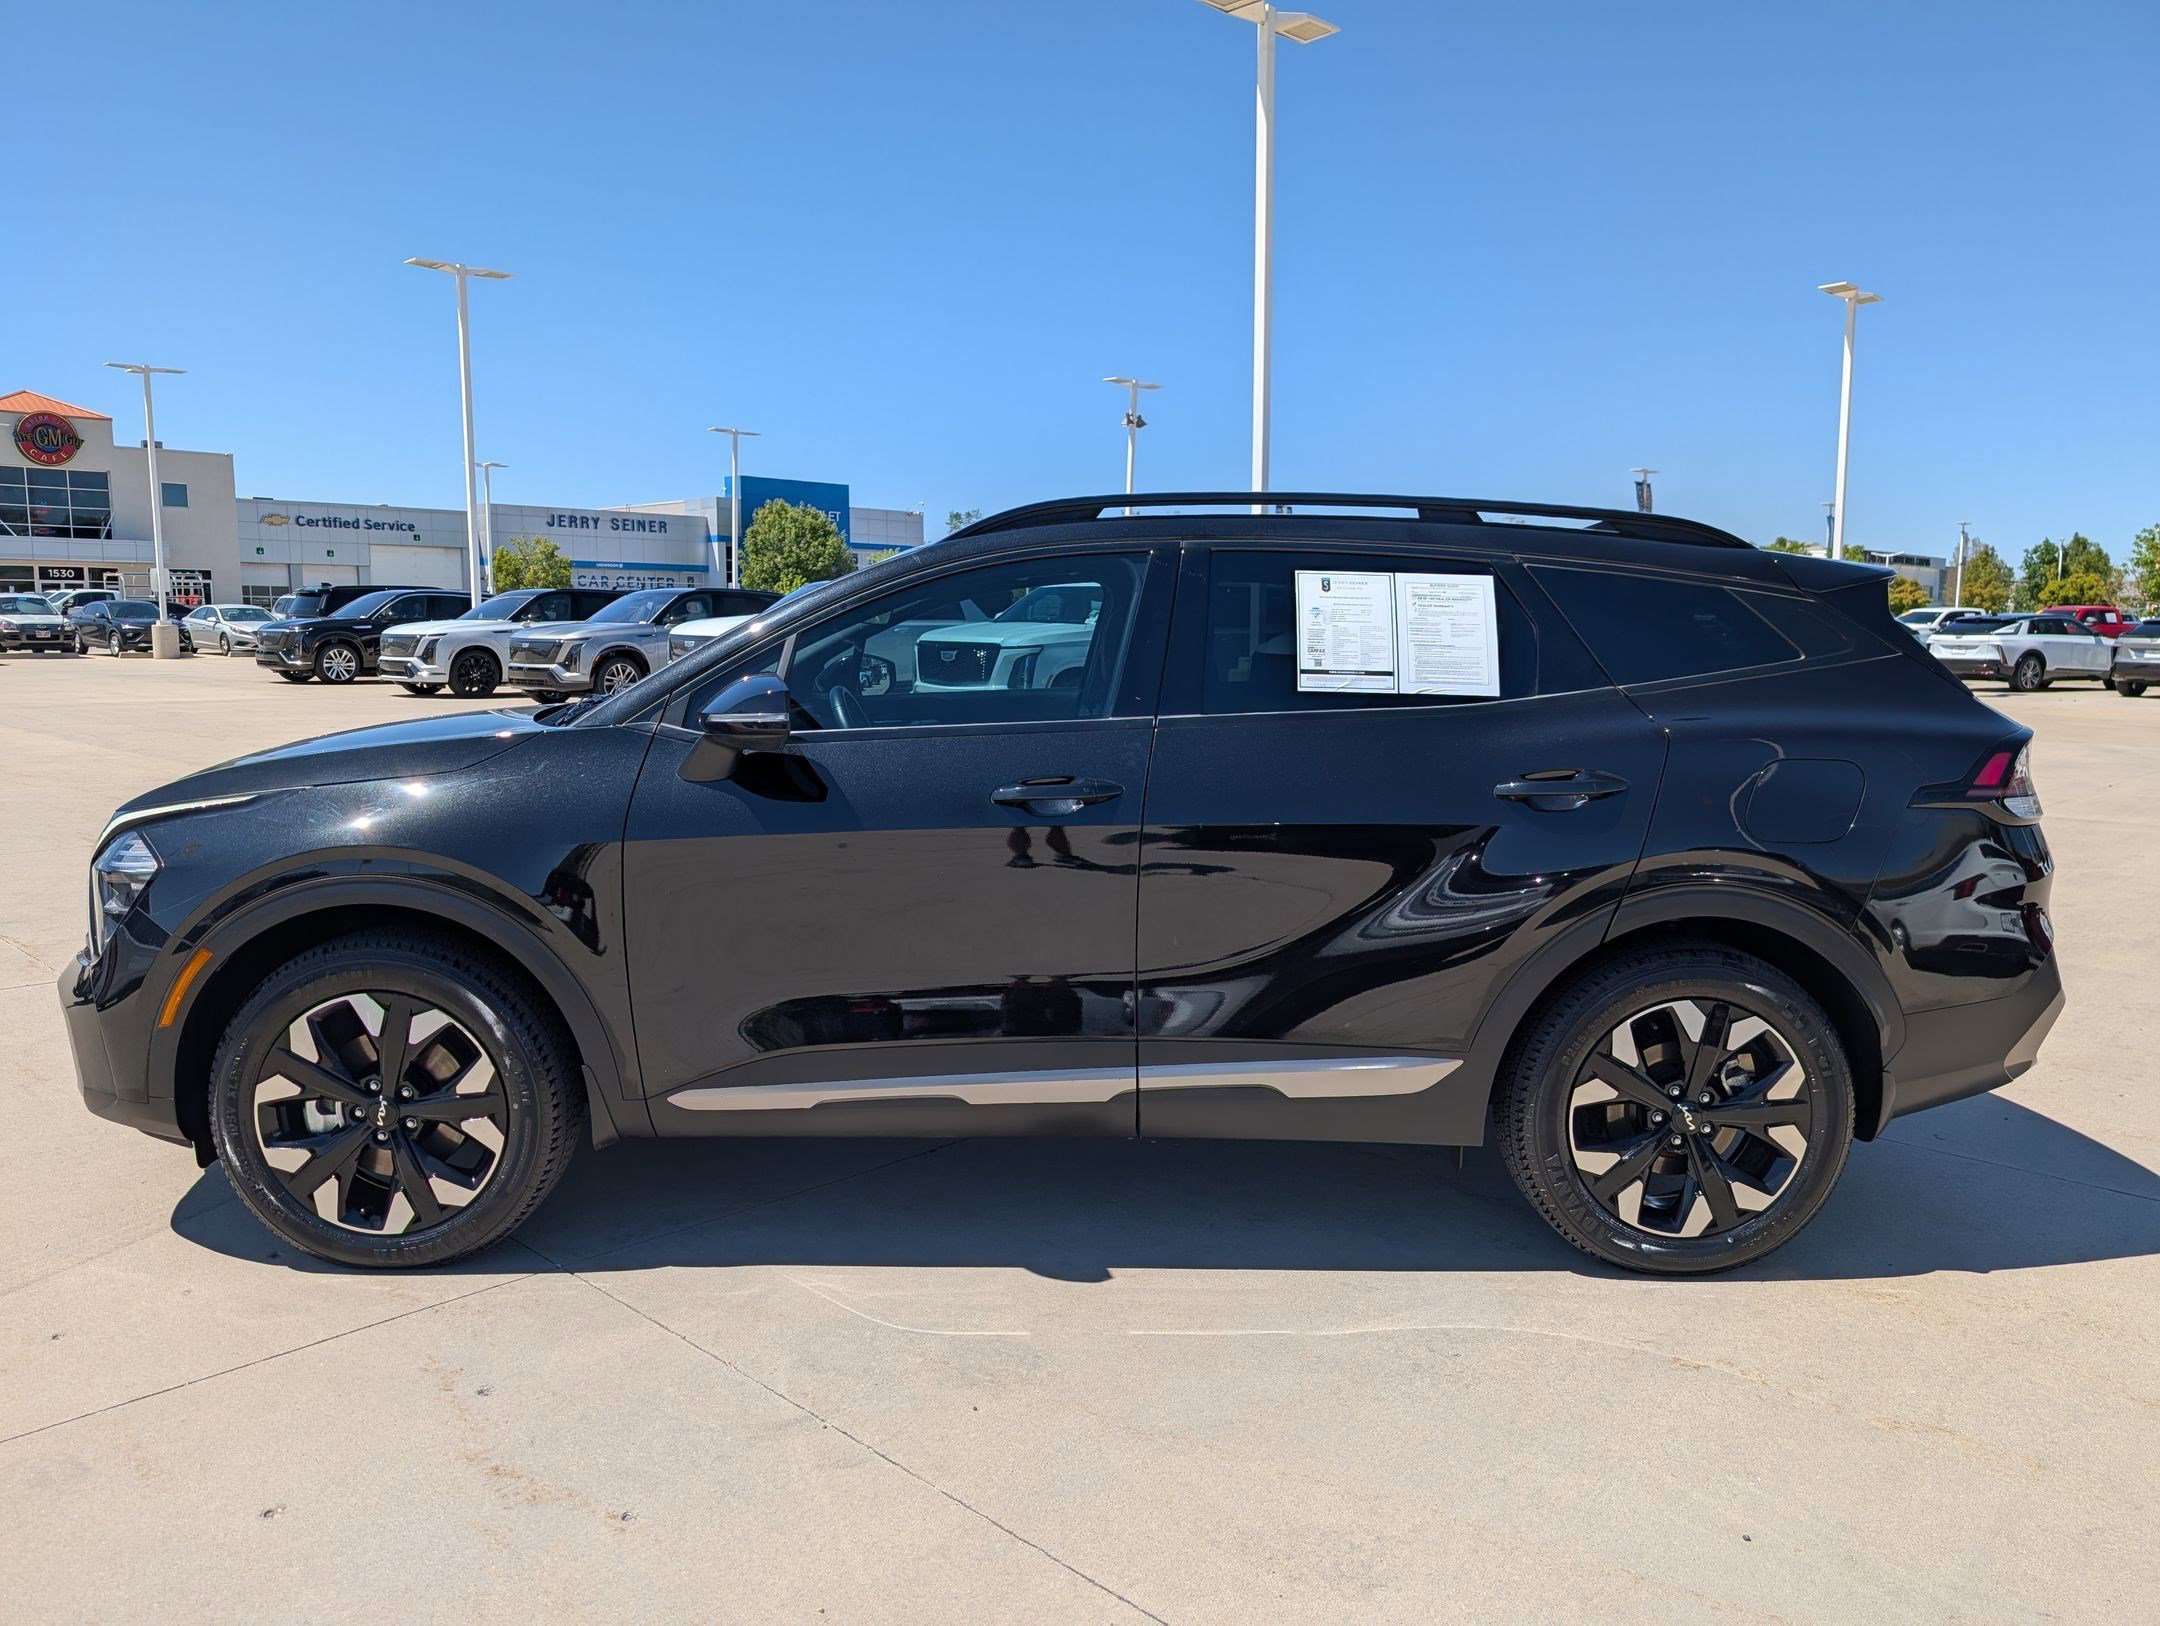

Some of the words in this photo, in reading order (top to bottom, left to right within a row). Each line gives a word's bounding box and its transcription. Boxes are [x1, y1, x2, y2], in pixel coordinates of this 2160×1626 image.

[35, 426, 62, 449] GM
[30, 449, 68, 462] CAFE
[295, 515, 360, 529] Certified
[364, 519, 415, 532] Service
[547, 514, 600, 529] JERRY
[611, 518, 668, 533] SEINER
[48, 569, 75, 578] 1530
[577, 575, 609, 588] CAR
[616, 576, 675, 590] CENTER
